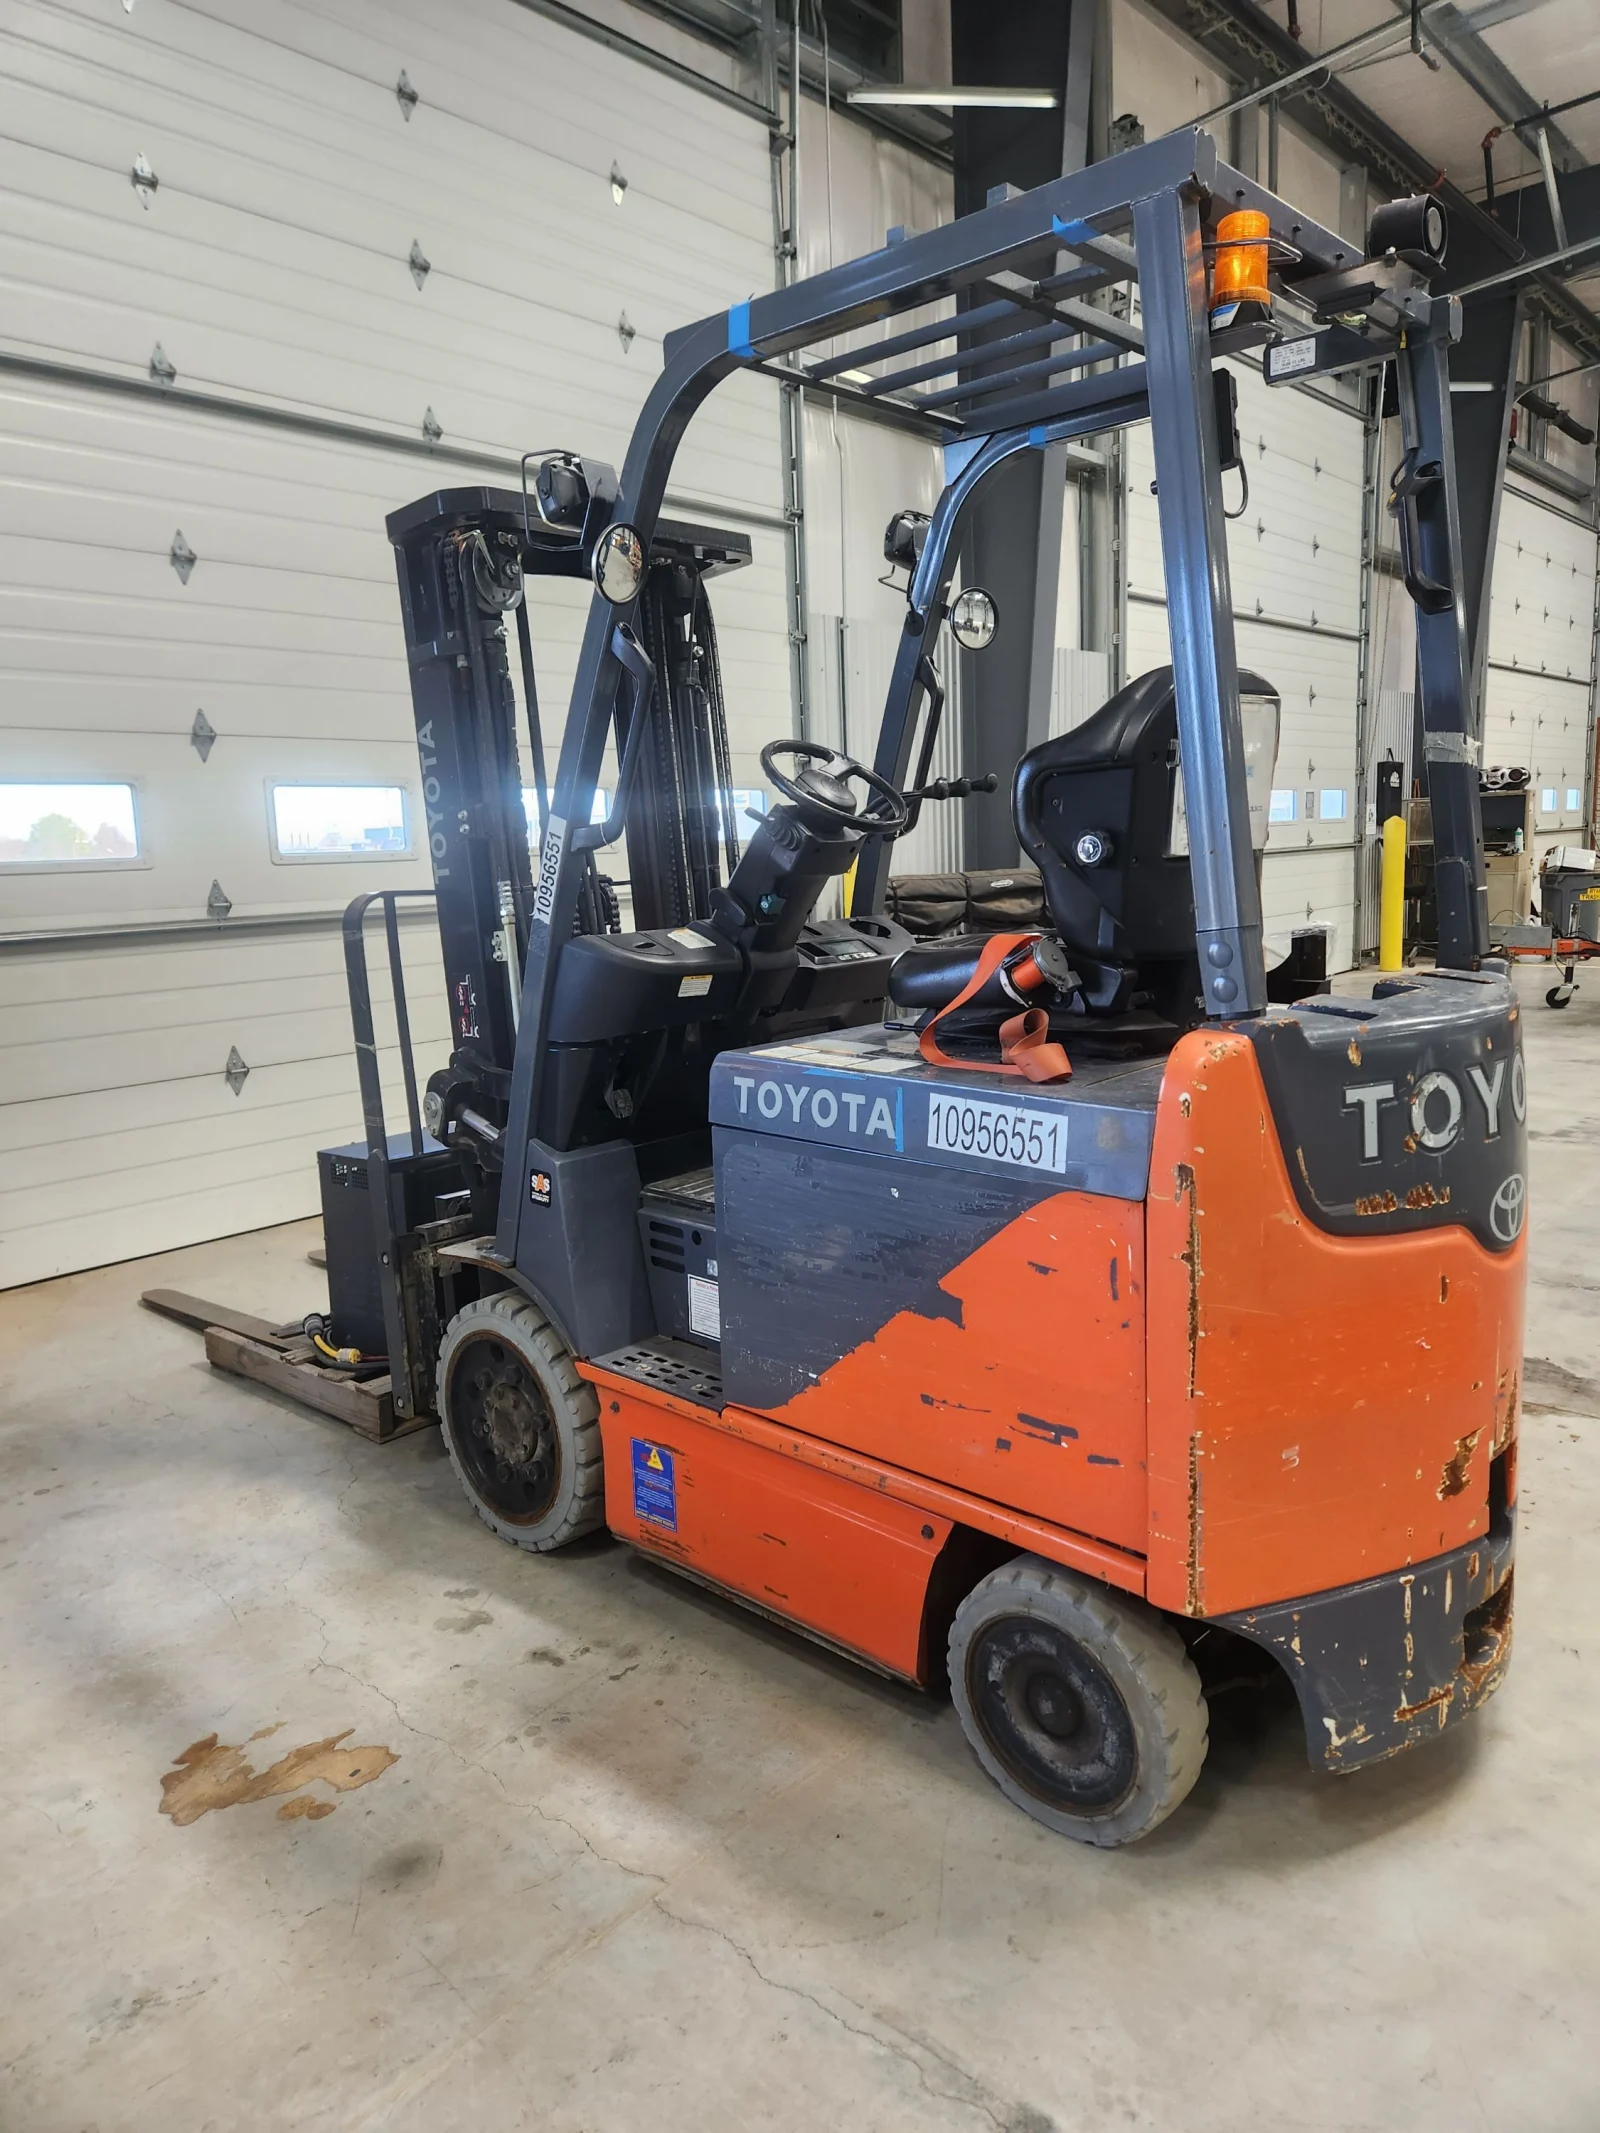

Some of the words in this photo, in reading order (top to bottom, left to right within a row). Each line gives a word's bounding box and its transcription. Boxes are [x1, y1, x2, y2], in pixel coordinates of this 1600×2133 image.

[418, 719, 450, 885] TOYOTA
[536, 831, 563, 917] 10956551
[733, 1076, 897, 1140] TOYOTA
[931, 1101, 1059, 1168] 10956551
[531, 1173, 551, 1193] SAS
